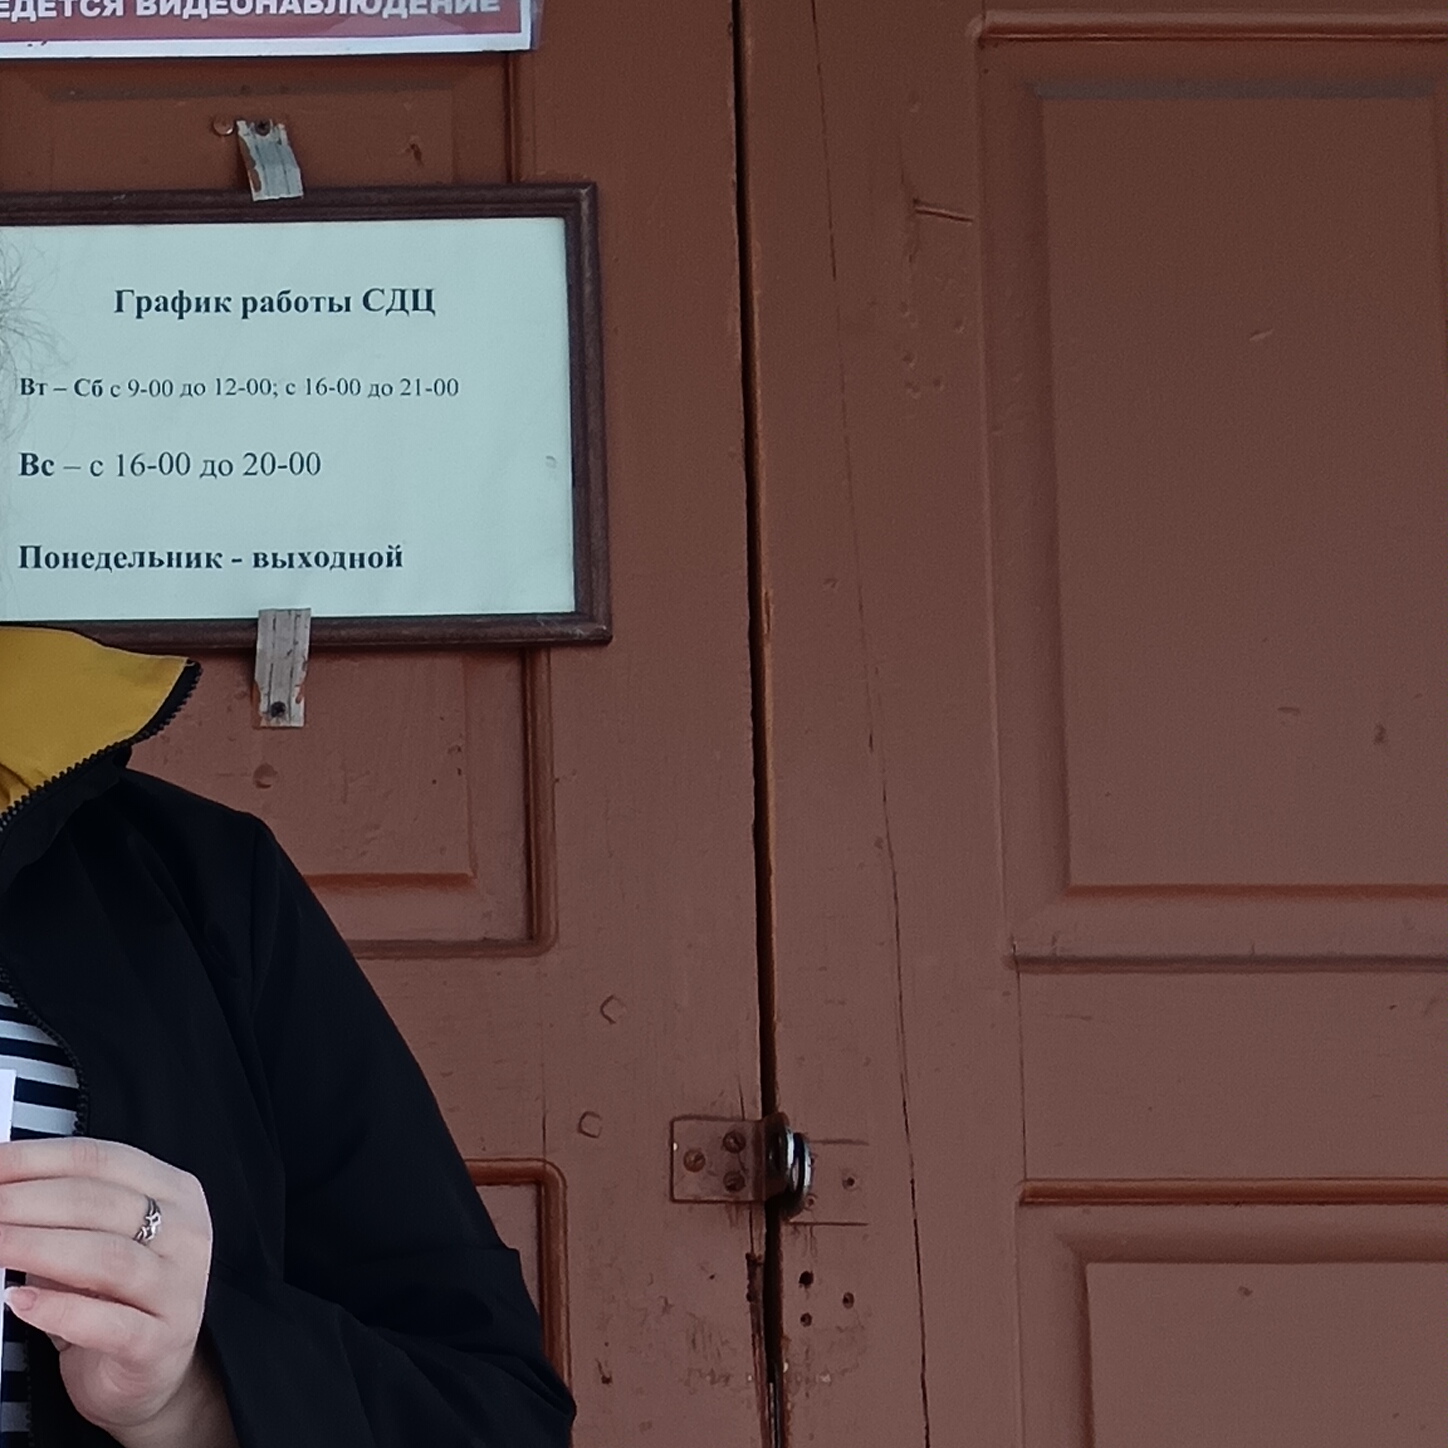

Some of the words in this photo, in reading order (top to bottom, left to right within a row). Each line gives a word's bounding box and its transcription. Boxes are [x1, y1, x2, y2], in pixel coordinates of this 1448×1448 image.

[115, 289, 232, 320] График
[241, 289, 351, 319] работы
[362, 288, 436, 316] СДЦ
[20, 377, 47, 396] Вт
[73, 378, 103, 397] Сб
[110, 385, 120, 398] с
[127, 379, 173, 397] 9-00
[179, 383, 206, 397] до
[216, 377, 278, 397] 12-00;
[285, 383, 295, 395] с
[306, 377, 361, 395] 16-00
[367, 383, 393, 398] до
[400, 378, 459, 396] 21-00
[20, 452, 54, 476] Вс
[89, 460, 103, 477] с
[118, 452, 190, 477] 16-00
[199, 459, 233, 479] до
[243, 451, 321, 476] 20-00
[19, 545, 222, 572] Понедельник
[253, 544, 402, 570] выходной
